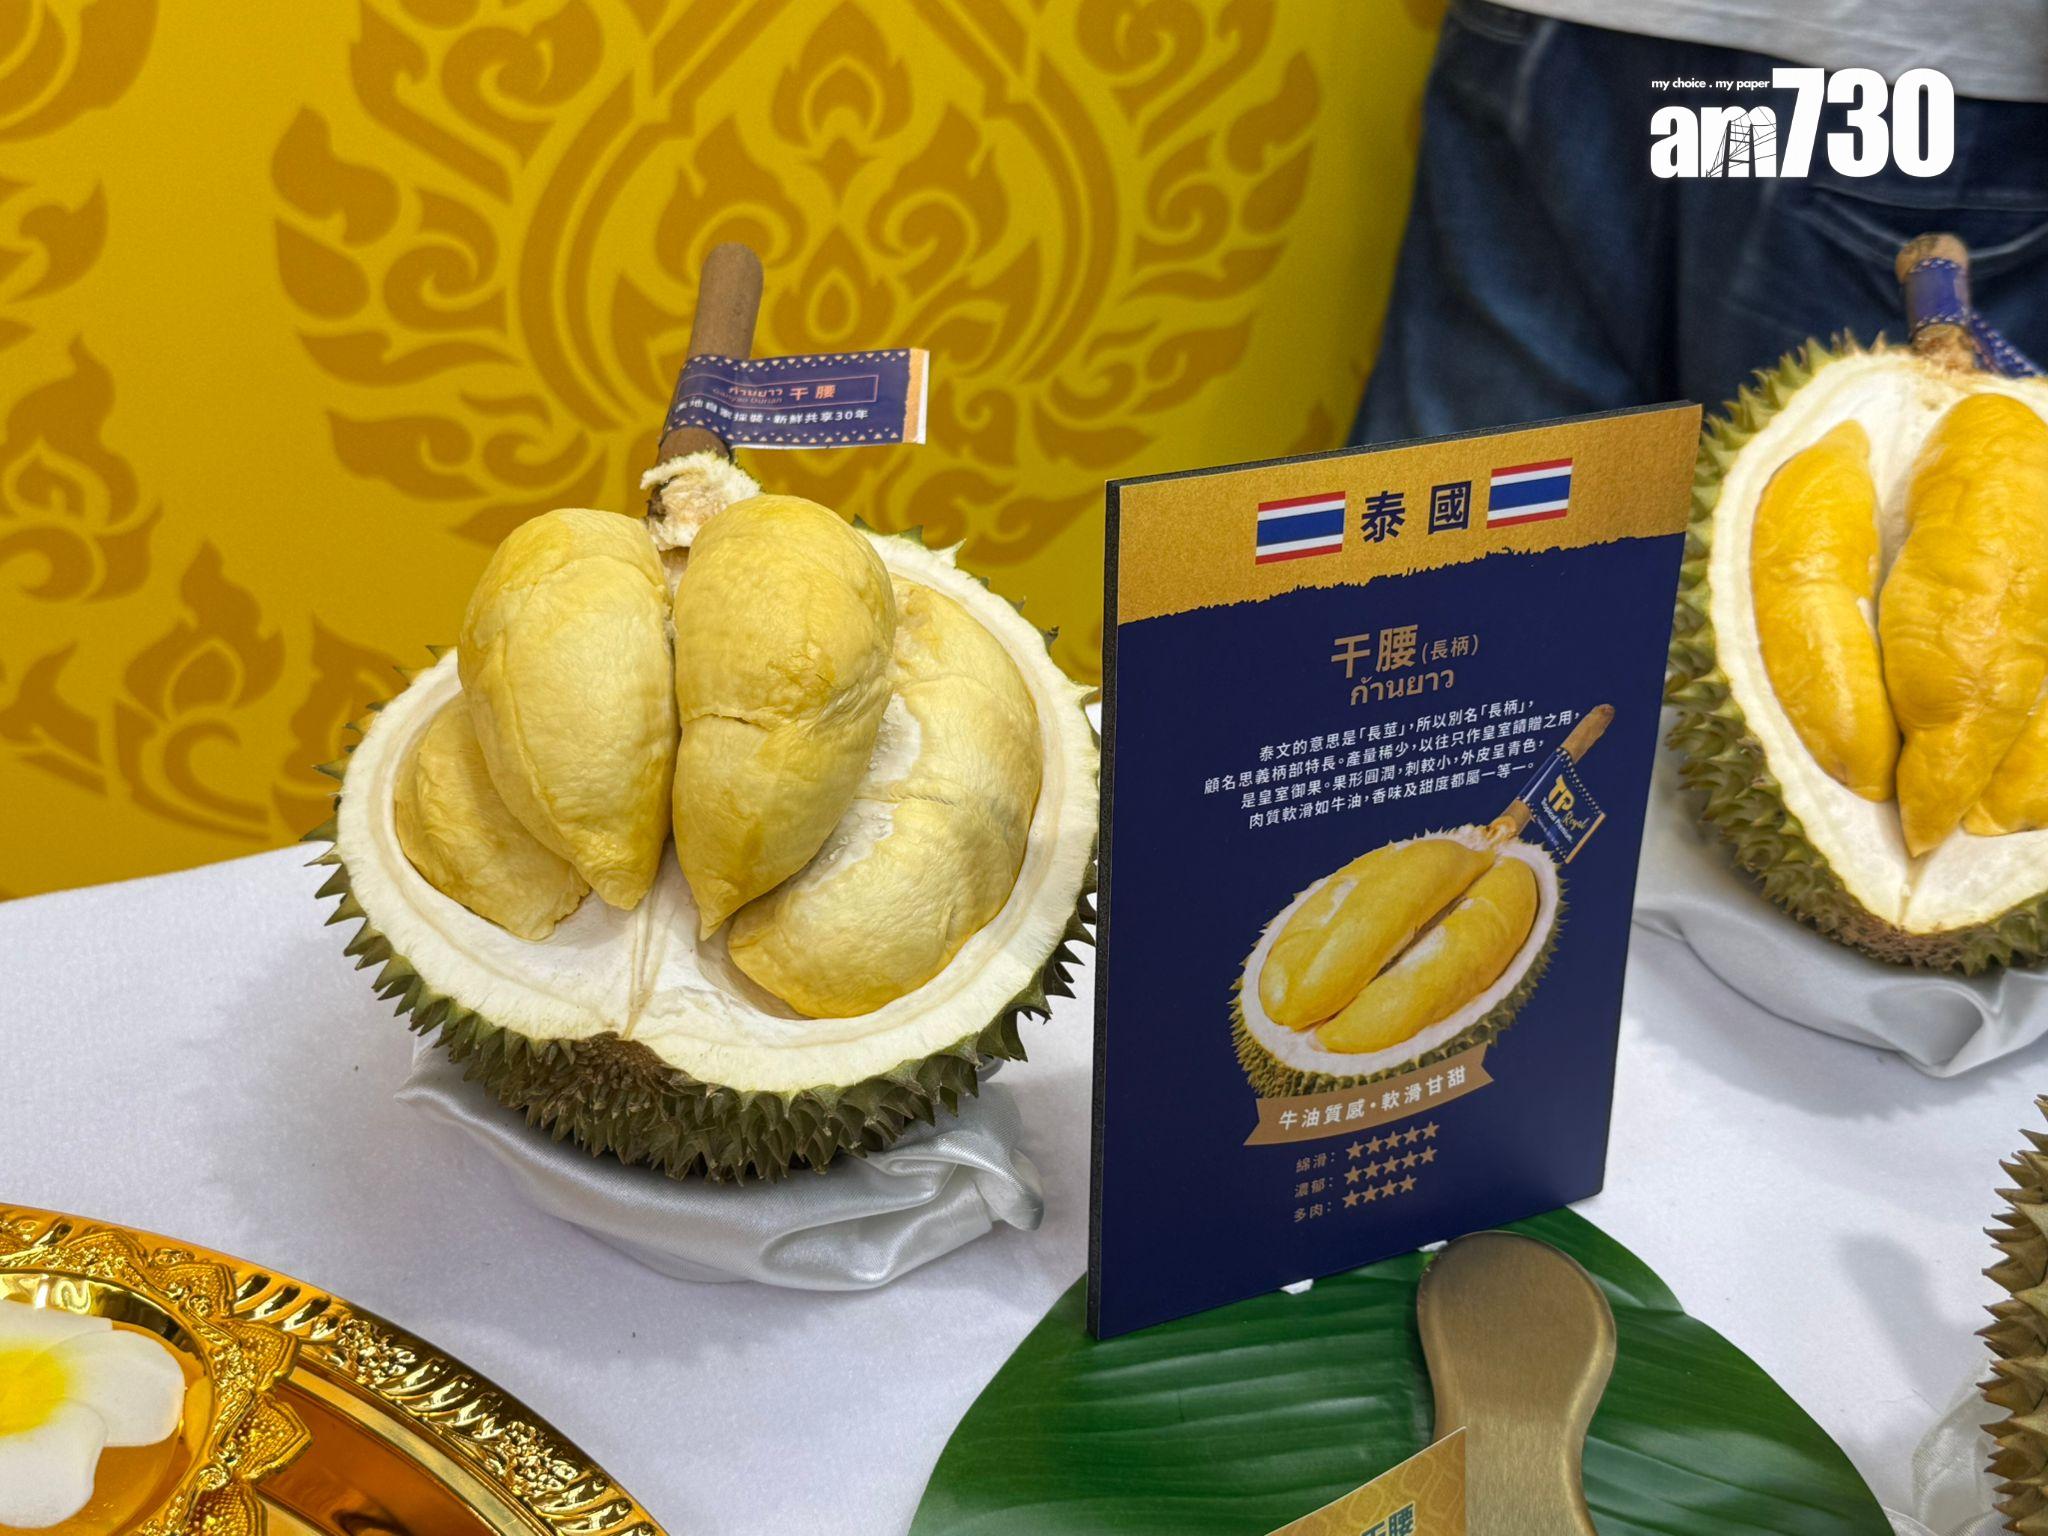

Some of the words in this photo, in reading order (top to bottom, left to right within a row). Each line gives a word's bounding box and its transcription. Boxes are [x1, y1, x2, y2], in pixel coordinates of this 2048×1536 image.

[1360, 480, 1472, 543] 泰國
[1350, 668, 1454, 706] ก้านยาว
